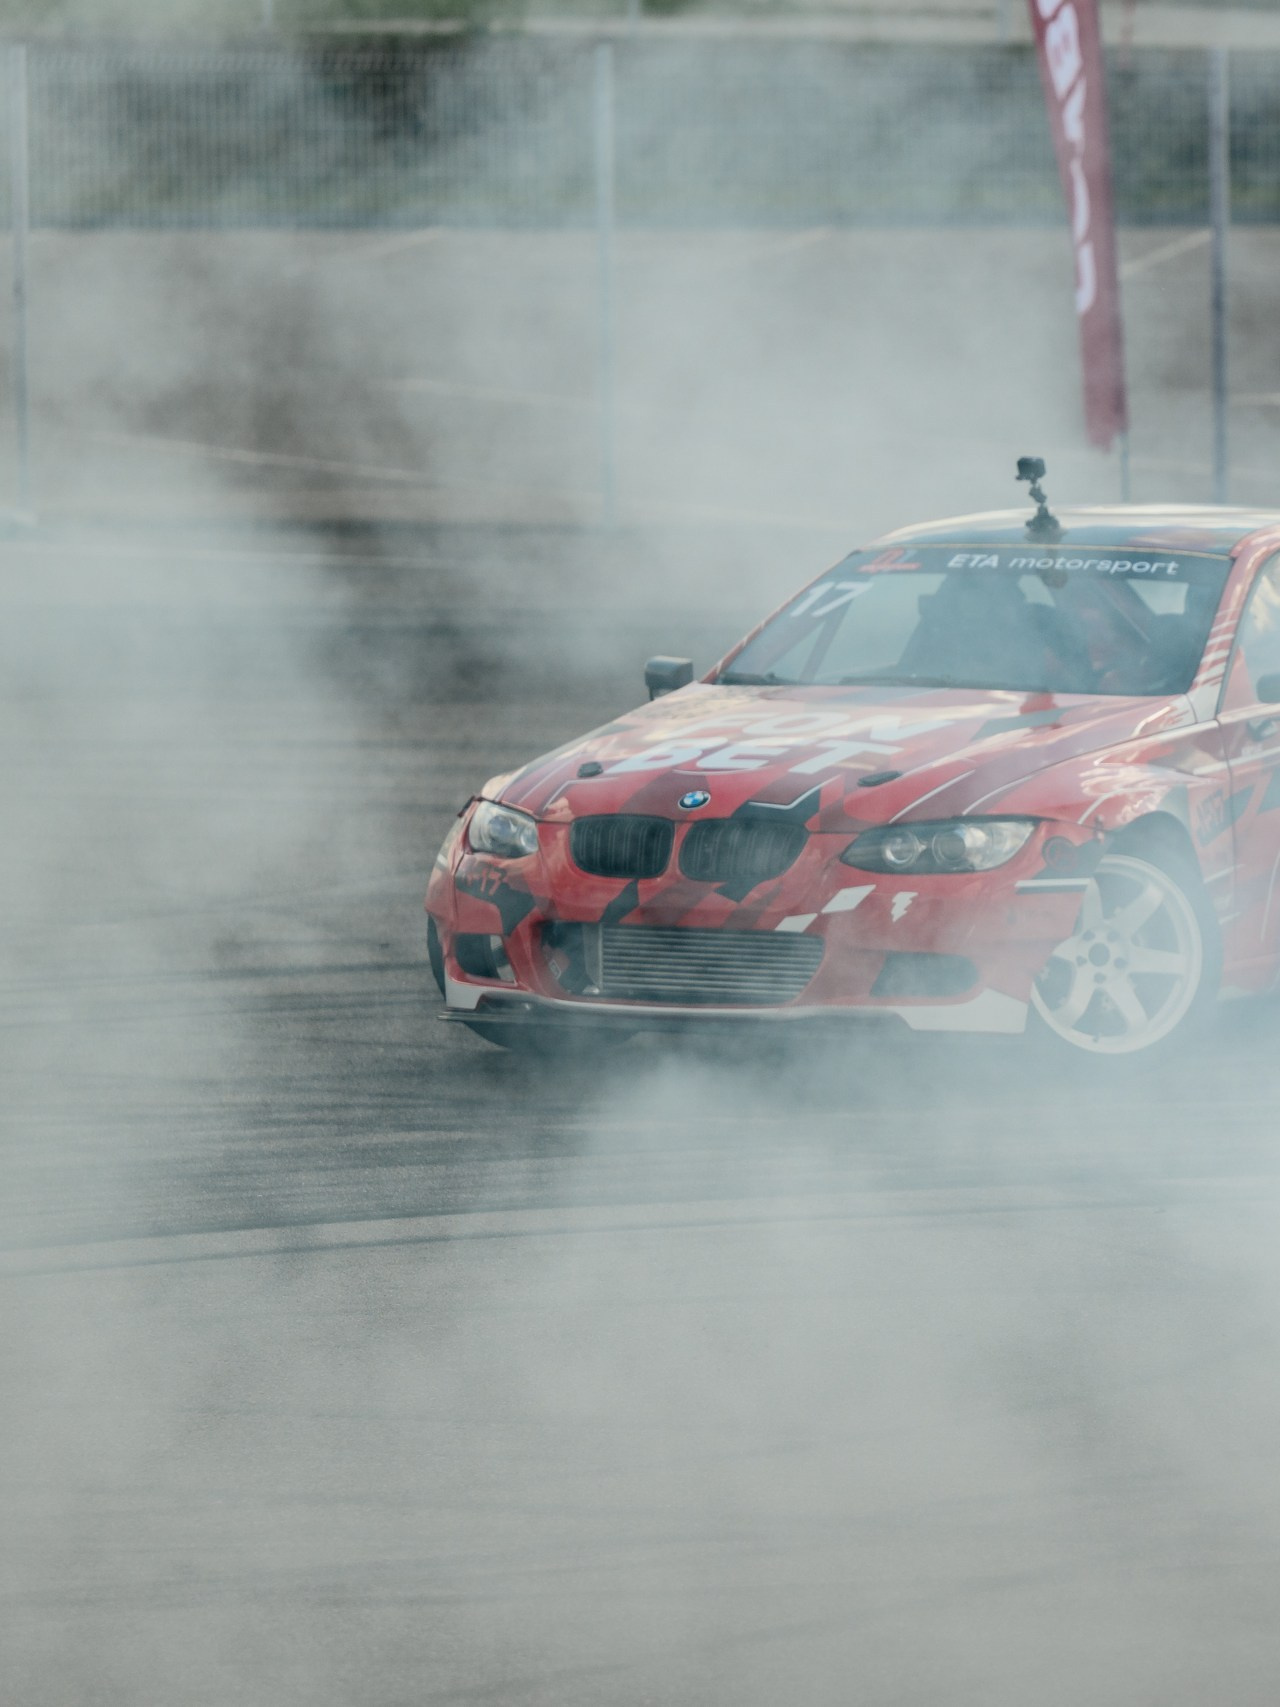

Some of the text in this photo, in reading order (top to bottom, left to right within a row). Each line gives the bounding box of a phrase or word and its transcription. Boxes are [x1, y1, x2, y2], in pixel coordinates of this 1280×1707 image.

[947, 553, 1181, 575] ETA motorsport
[790, 581, 874, 617] 17
[603, 737, 905, 775] BET
